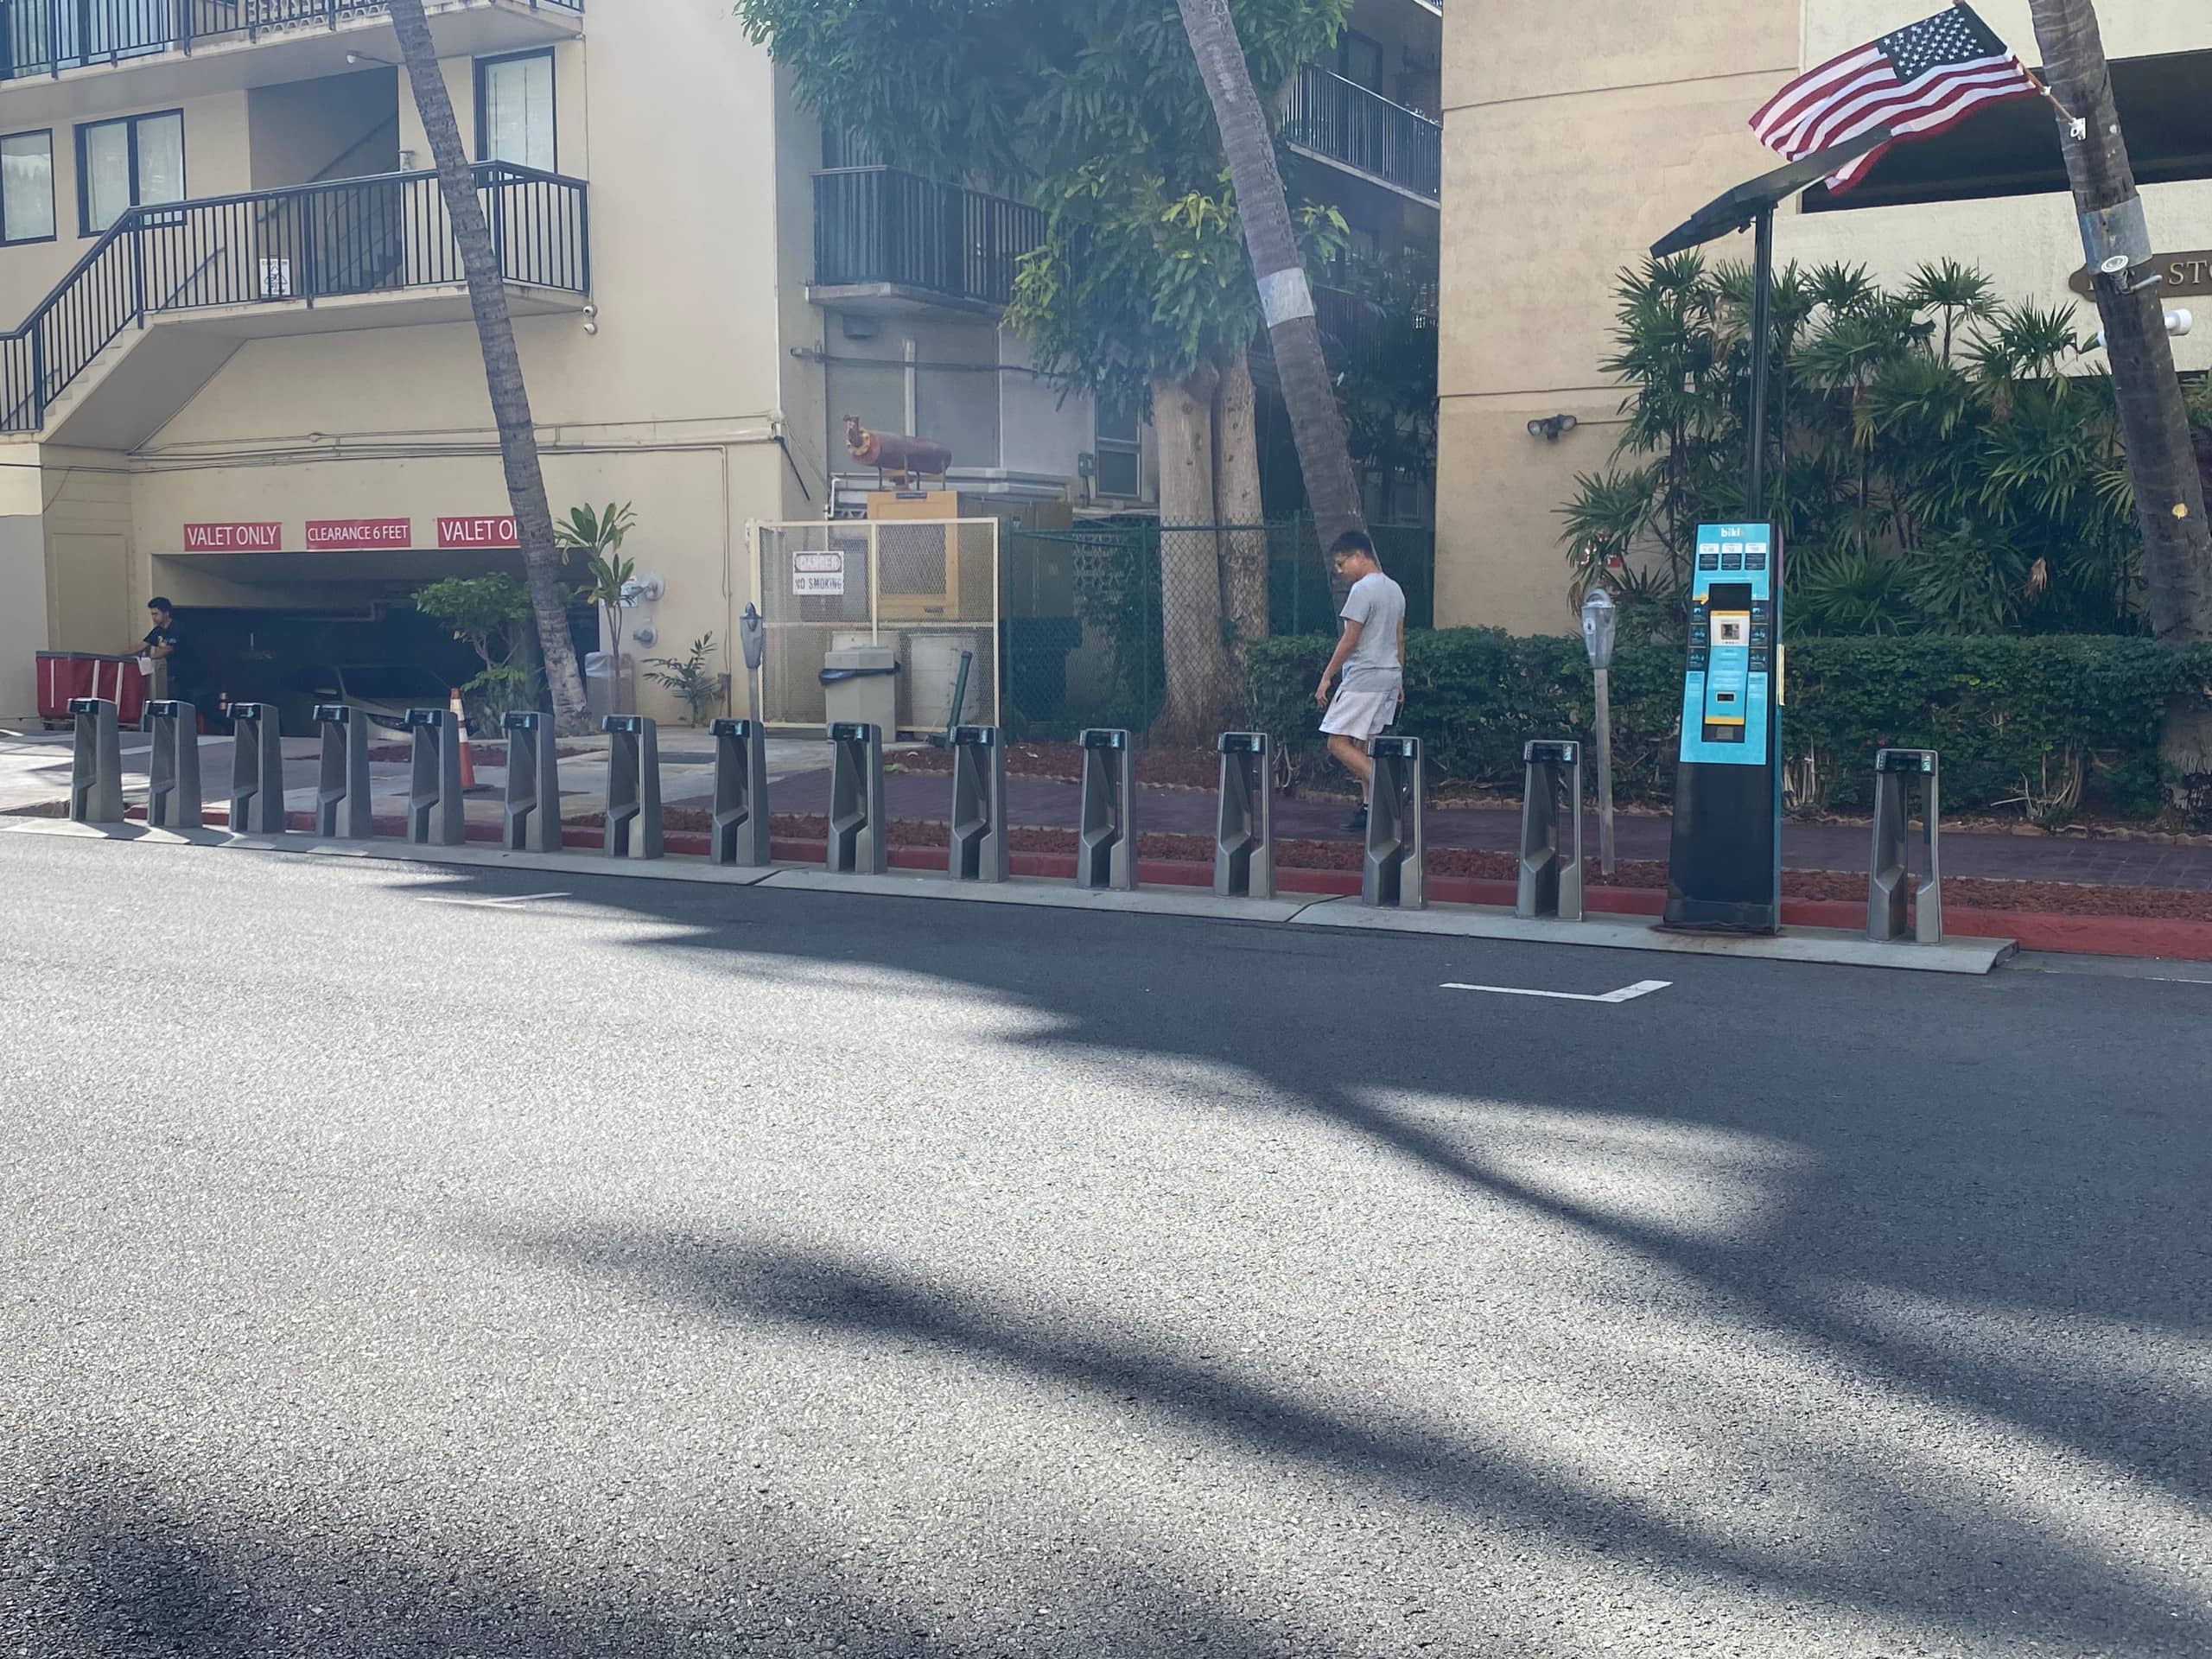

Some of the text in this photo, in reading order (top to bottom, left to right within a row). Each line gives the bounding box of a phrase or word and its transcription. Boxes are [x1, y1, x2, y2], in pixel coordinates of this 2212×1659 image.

[2169, 259, 2212, 285] ST
[187, 525, 277, 546] VALET ONLY
[308, 524, 408, 542] CLEARANCE 6 FEET
[442, 520, 495, 541] VALET
[795, 577, 842, 589] NO SMOKING
